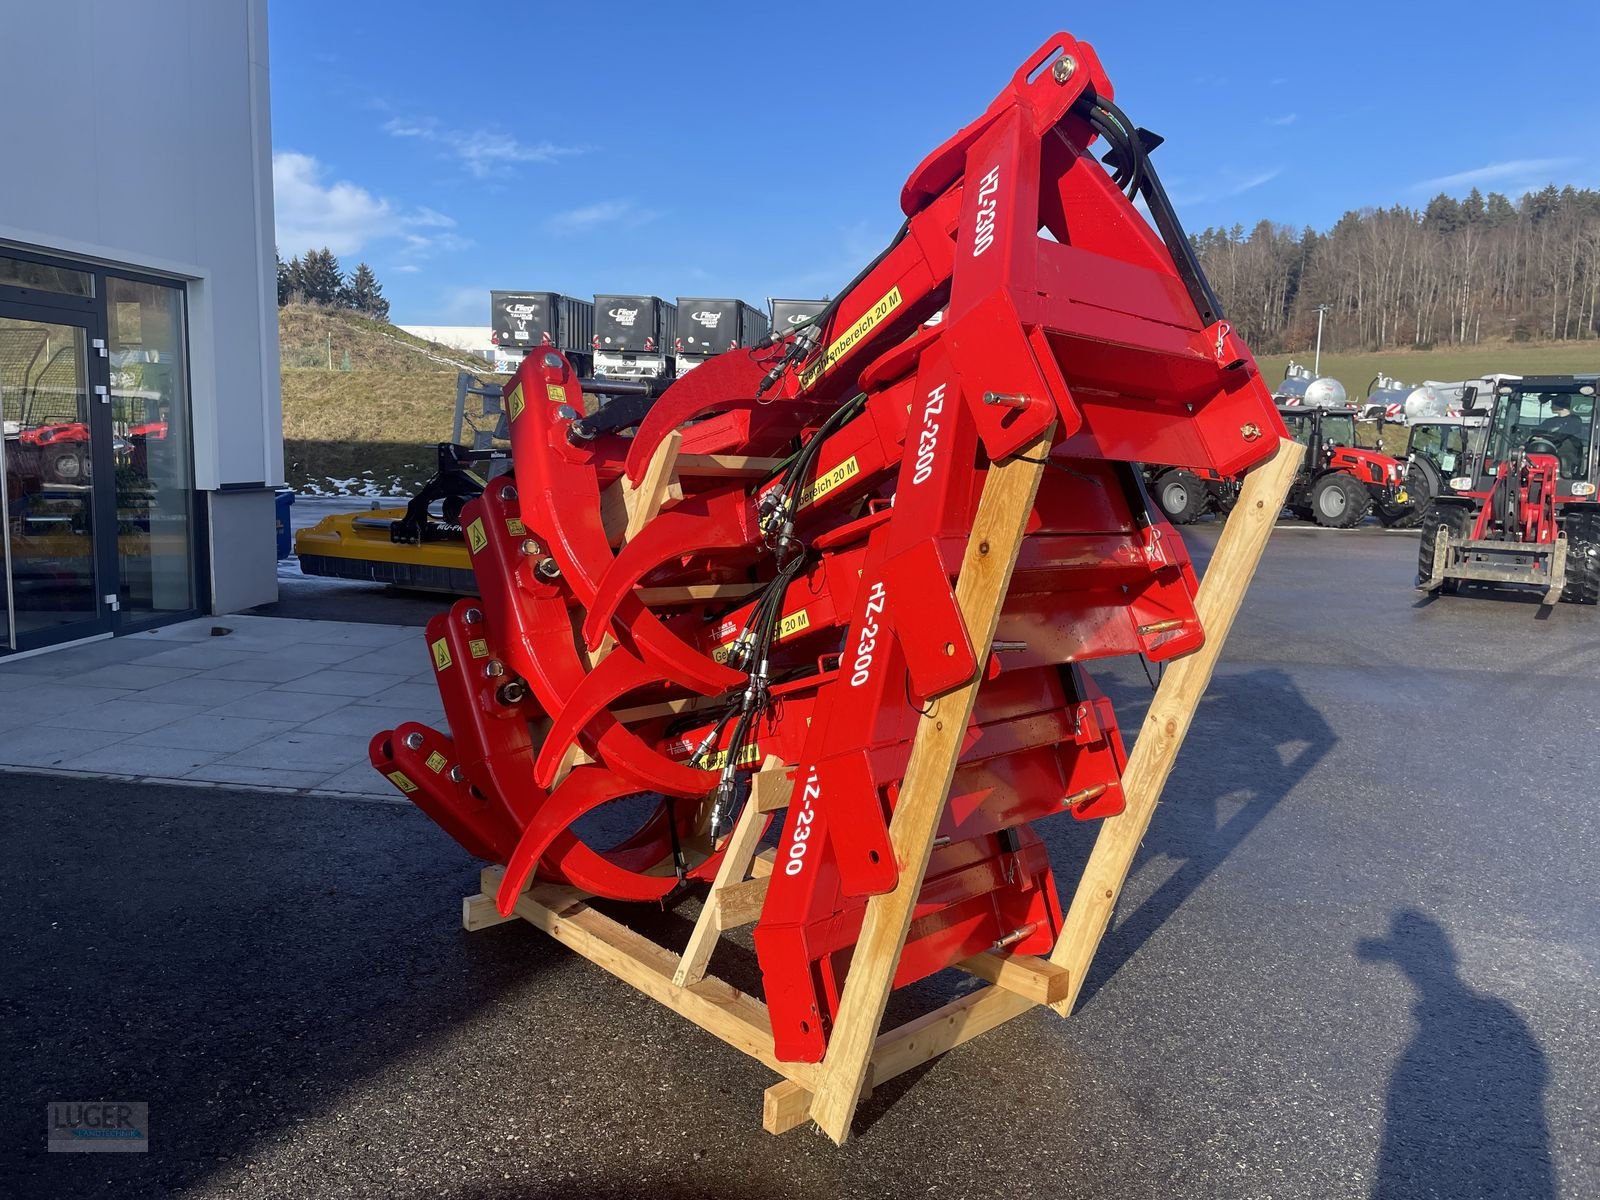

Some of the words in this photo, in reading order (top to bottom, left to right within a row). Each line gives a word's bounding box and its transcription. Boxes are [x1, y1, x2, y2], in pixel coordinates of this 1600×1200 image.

[973, 165, 1000, 257] HZ-2300
[875, 304, 887, 320] 20
[888, 291, 899, 306] M
[912, 383, 946, 485] HZ-2300
[833, 468, 845, 484] 20
[847, 460, 856, 474] M
[784, 619, 796, 633] 20
[798, 613, 806, 625] M
[850, 582, 886, 687] HZ-2300
